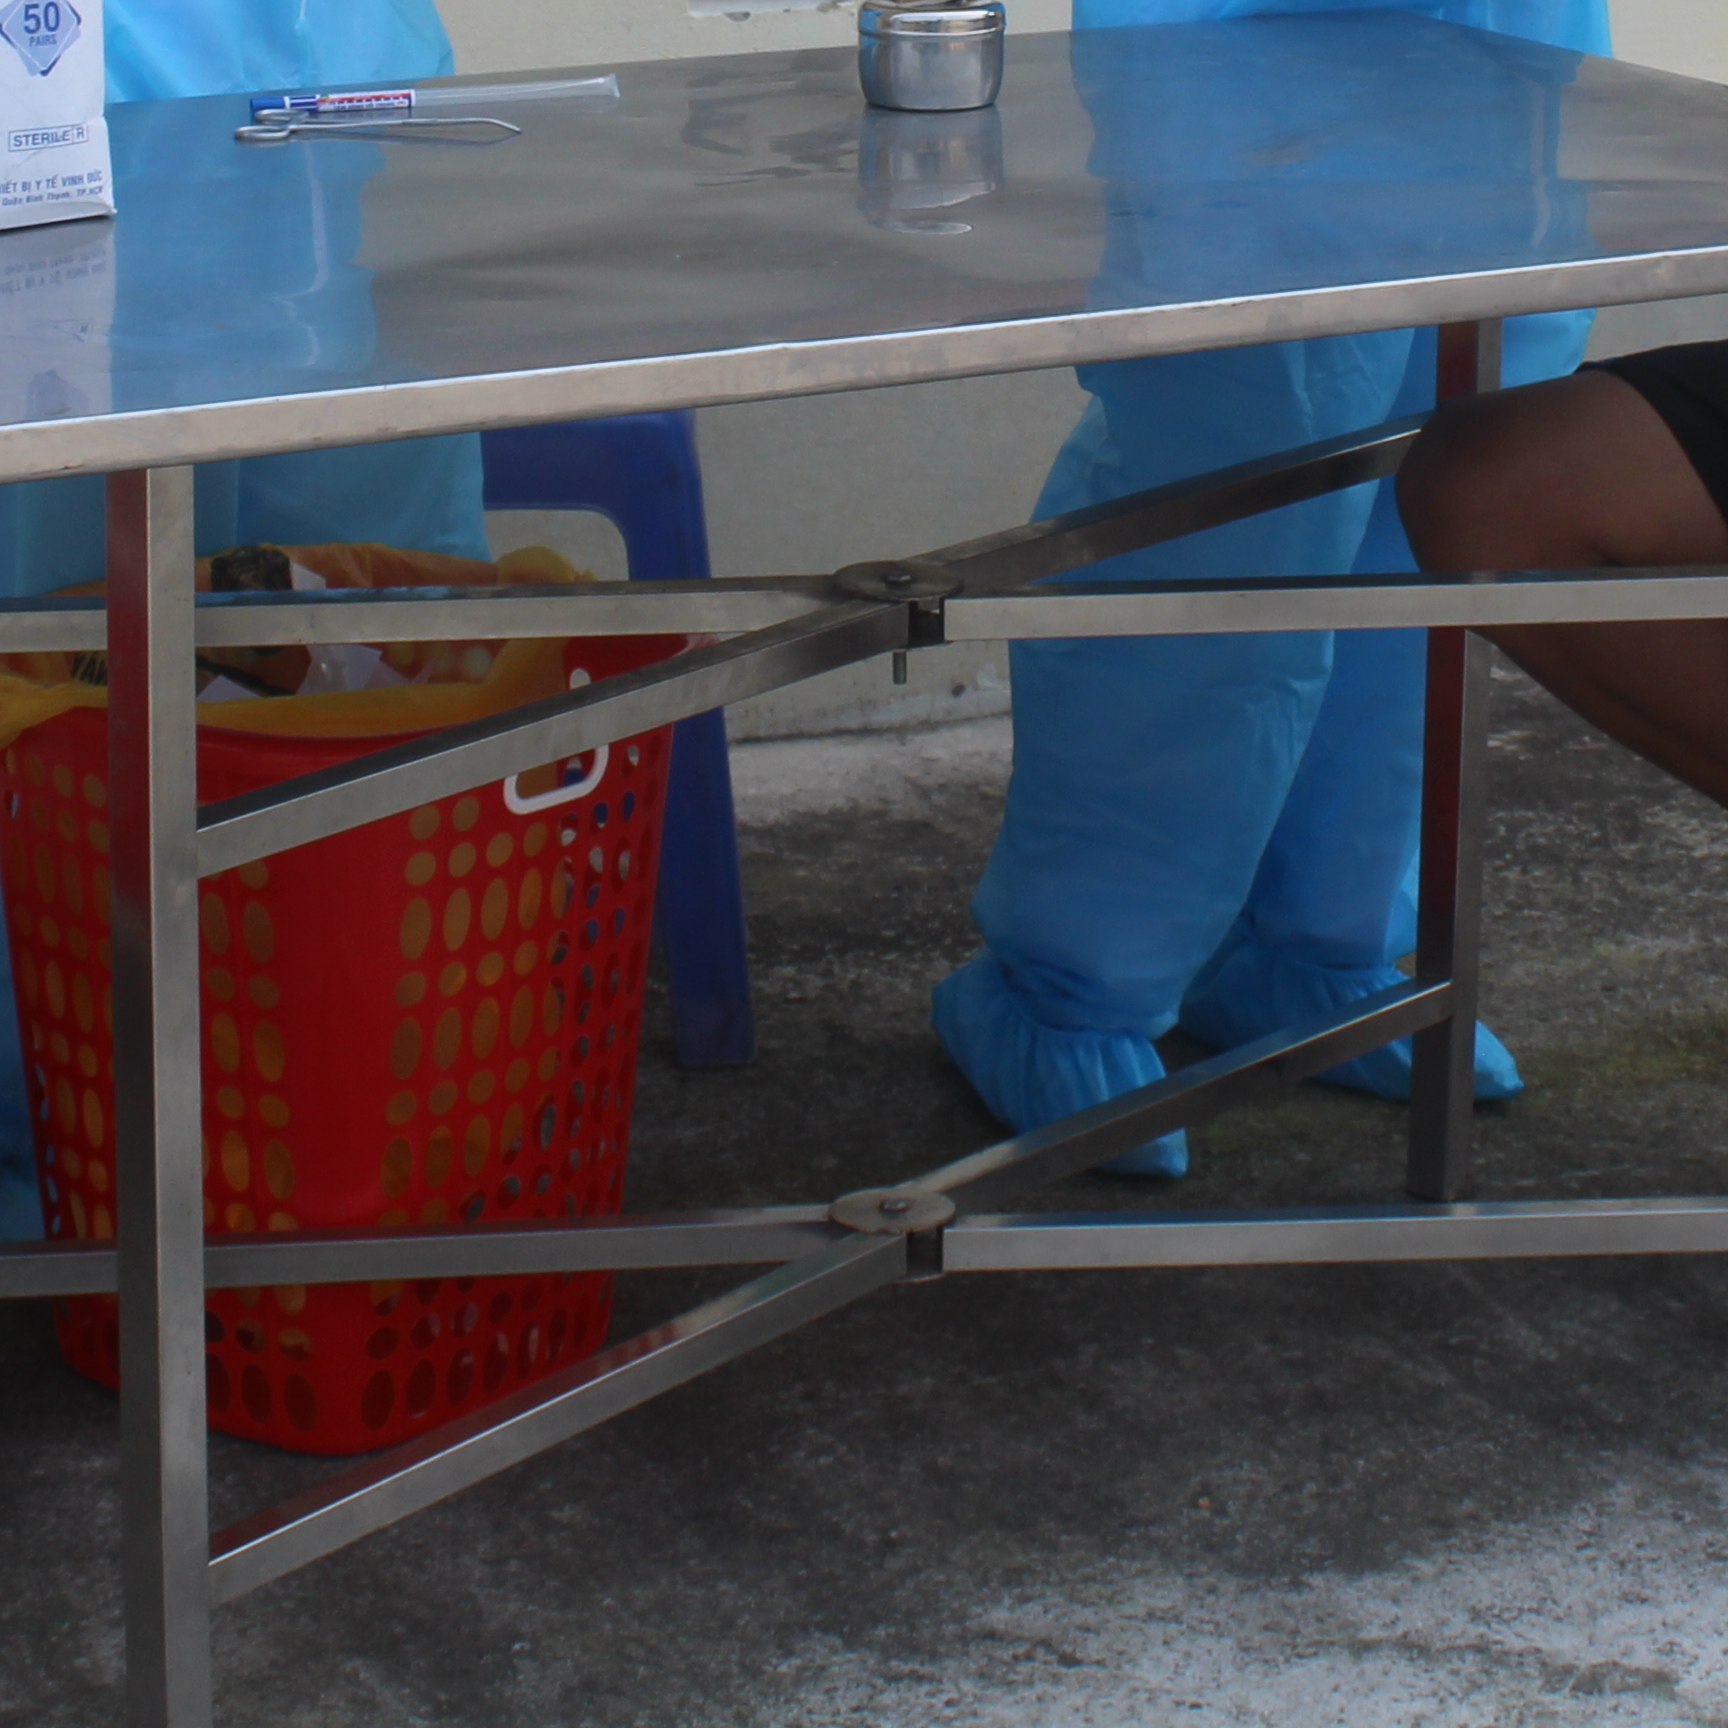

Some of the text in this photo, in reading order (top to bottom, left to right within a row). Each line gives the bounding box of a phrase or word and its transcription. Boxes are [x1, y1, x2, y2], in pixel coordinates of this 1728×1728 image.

[23, 1, 60, 34] 50
[29, 34, 57, 46] PAIRS
[13, 127, 84, 147] STERILE R
[35, 179, 42, 191] Y
